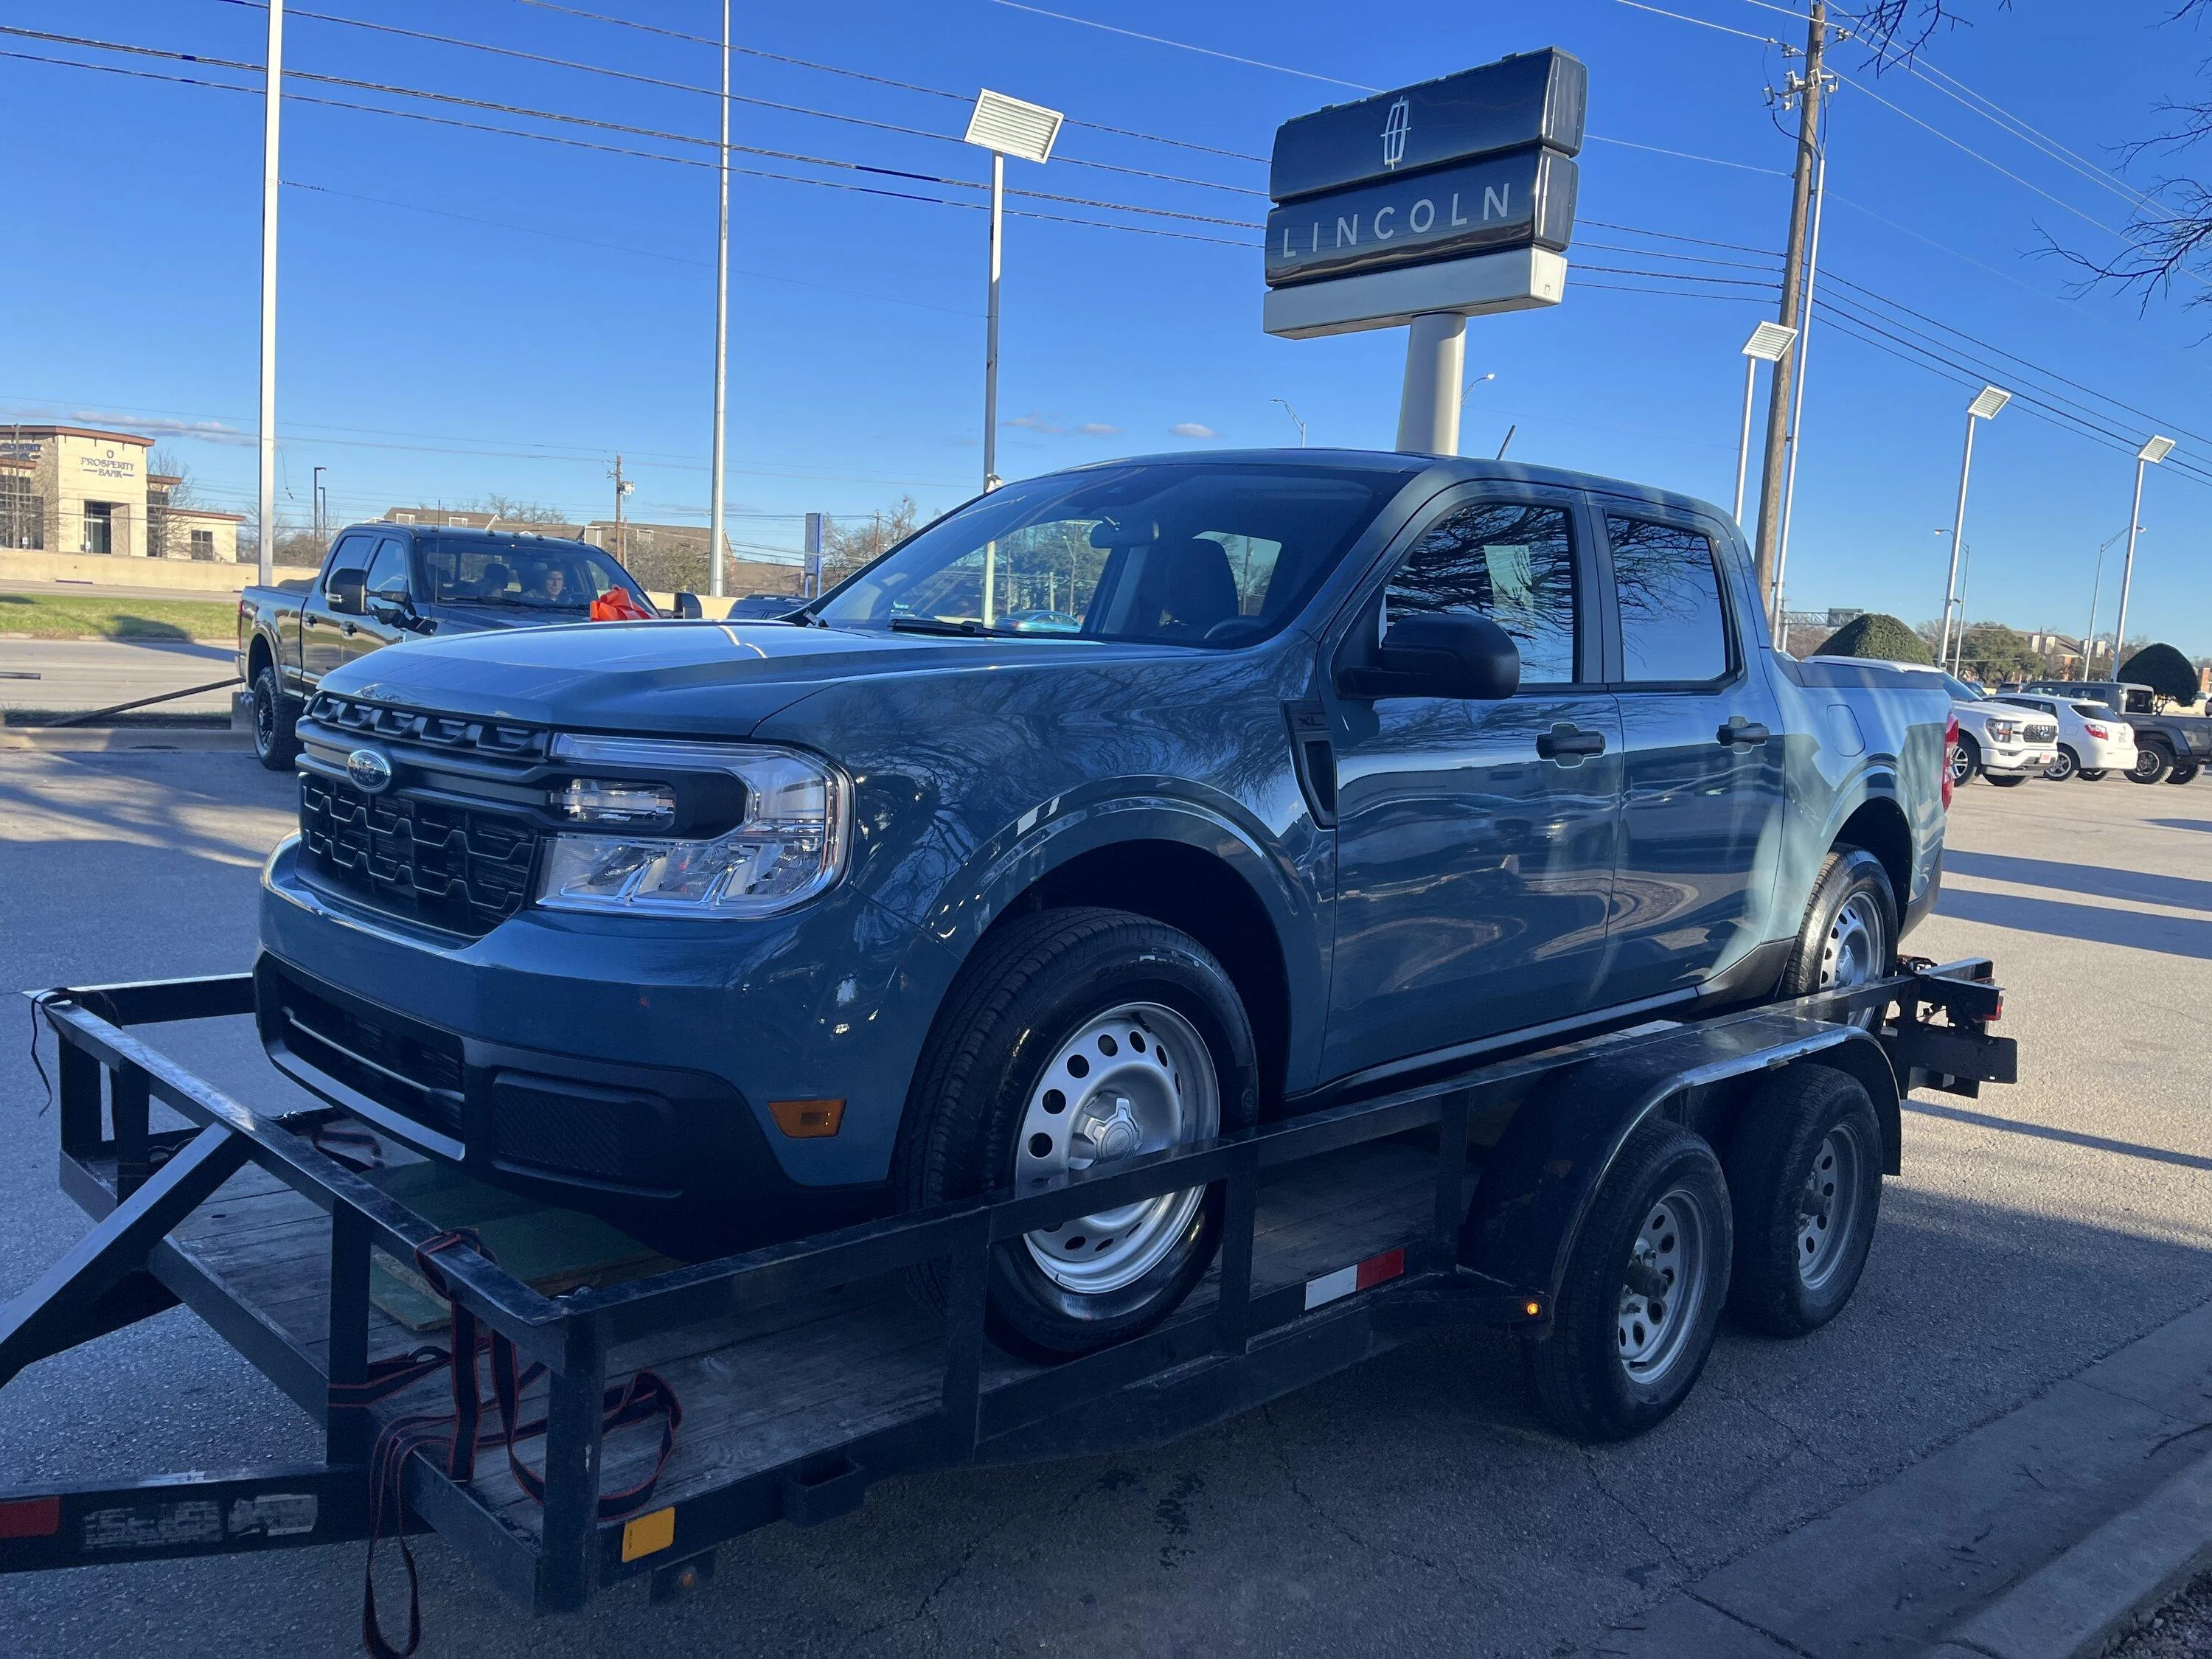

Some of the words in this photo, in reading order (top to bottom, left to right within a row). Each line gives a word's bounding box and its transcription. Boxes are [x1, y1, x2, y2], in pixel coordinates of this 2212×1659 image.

[1283, 183, 1509, 258] LINCOLN
[81, 457, 133, 470] PROSPERITY
[98, 468, 122, 478] BANK
